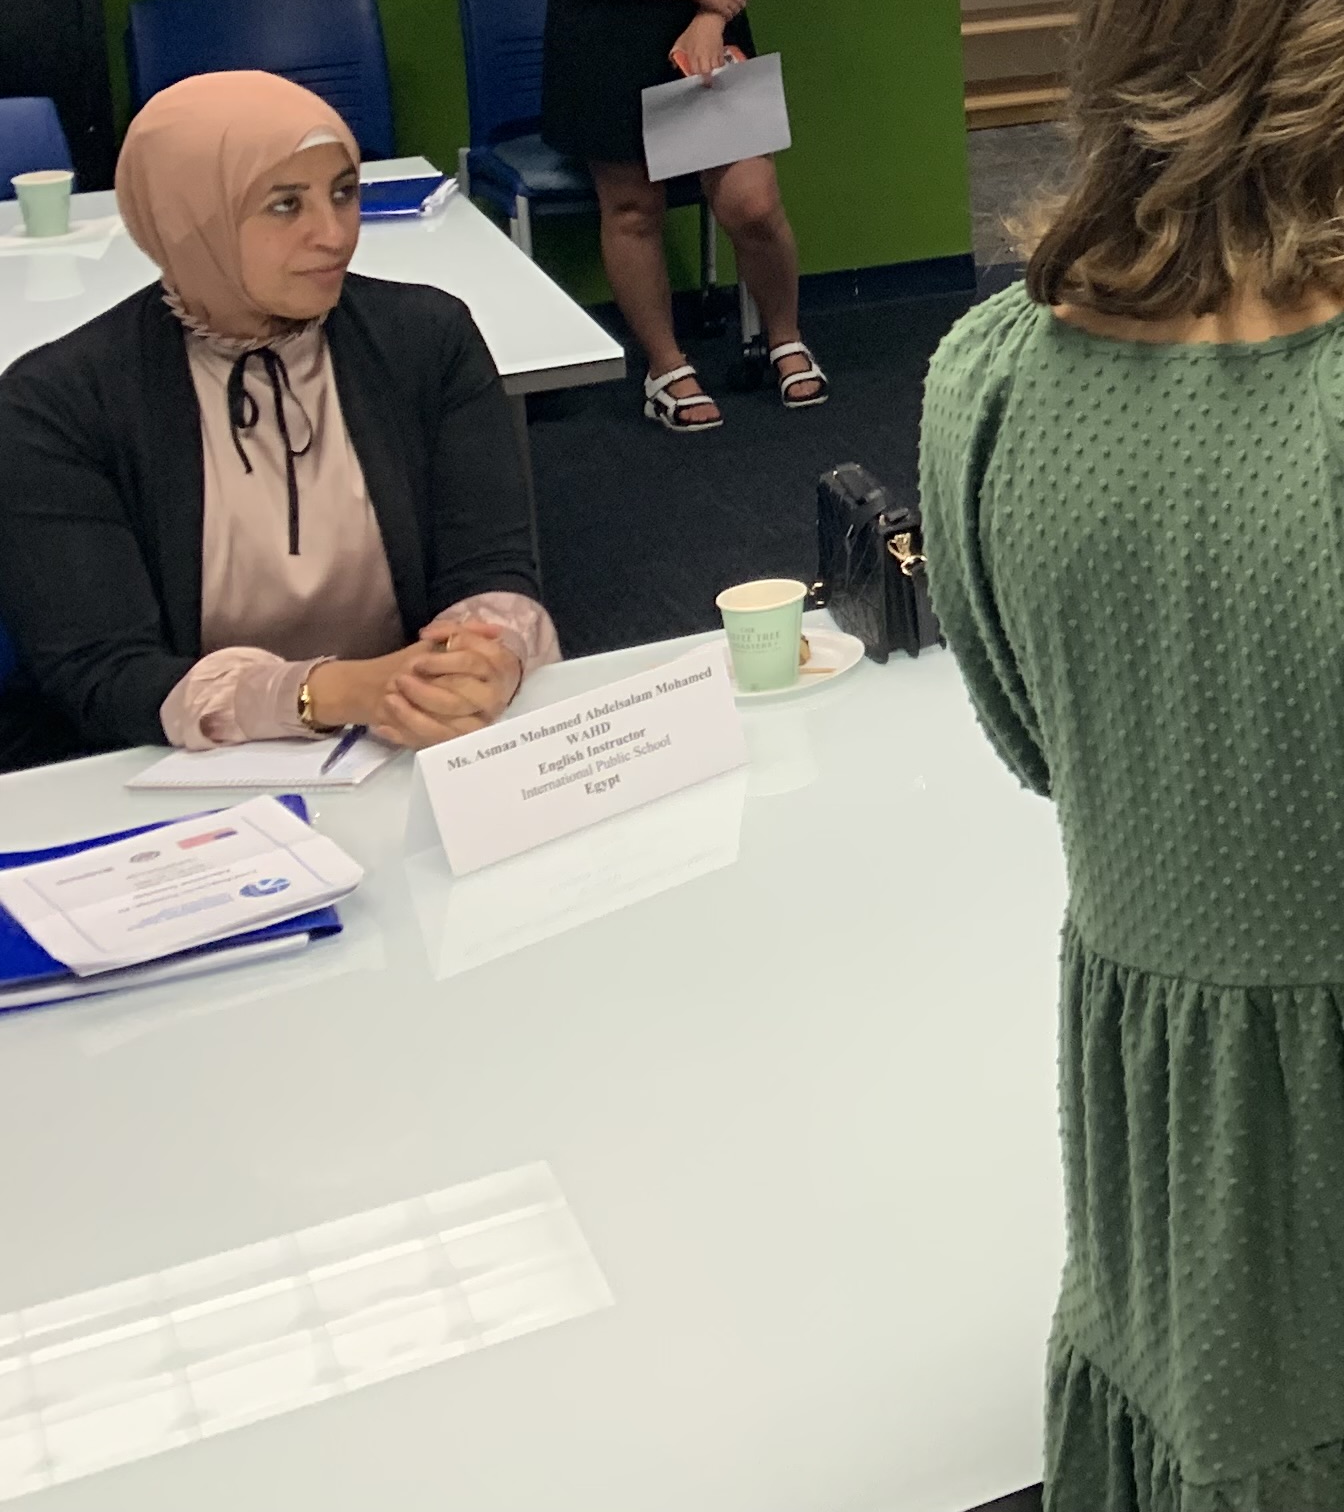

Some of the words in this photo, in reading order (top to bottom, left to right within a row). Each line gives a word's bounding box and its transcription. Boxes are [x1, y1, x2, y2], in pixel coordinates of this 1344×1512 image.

[447, 755, 472, 772] Ms.
[475, 738, 517, 760] Asmaa
[519, 713, 582, 744] Mohamed
[584, 690, 653, 723] Abdelsalam
[655, 666, 713, 696] Mohamed
[565, 721, 612, 746] WAHD
[521, 765, 594, 801] International
[596, 748, 631, 773] Public
[633, 733, 673, 758] School
[537, 750, 584, 776] English
[587, 727, 647, 757] Instructor
[584, 772, 621, 796] Egypt
